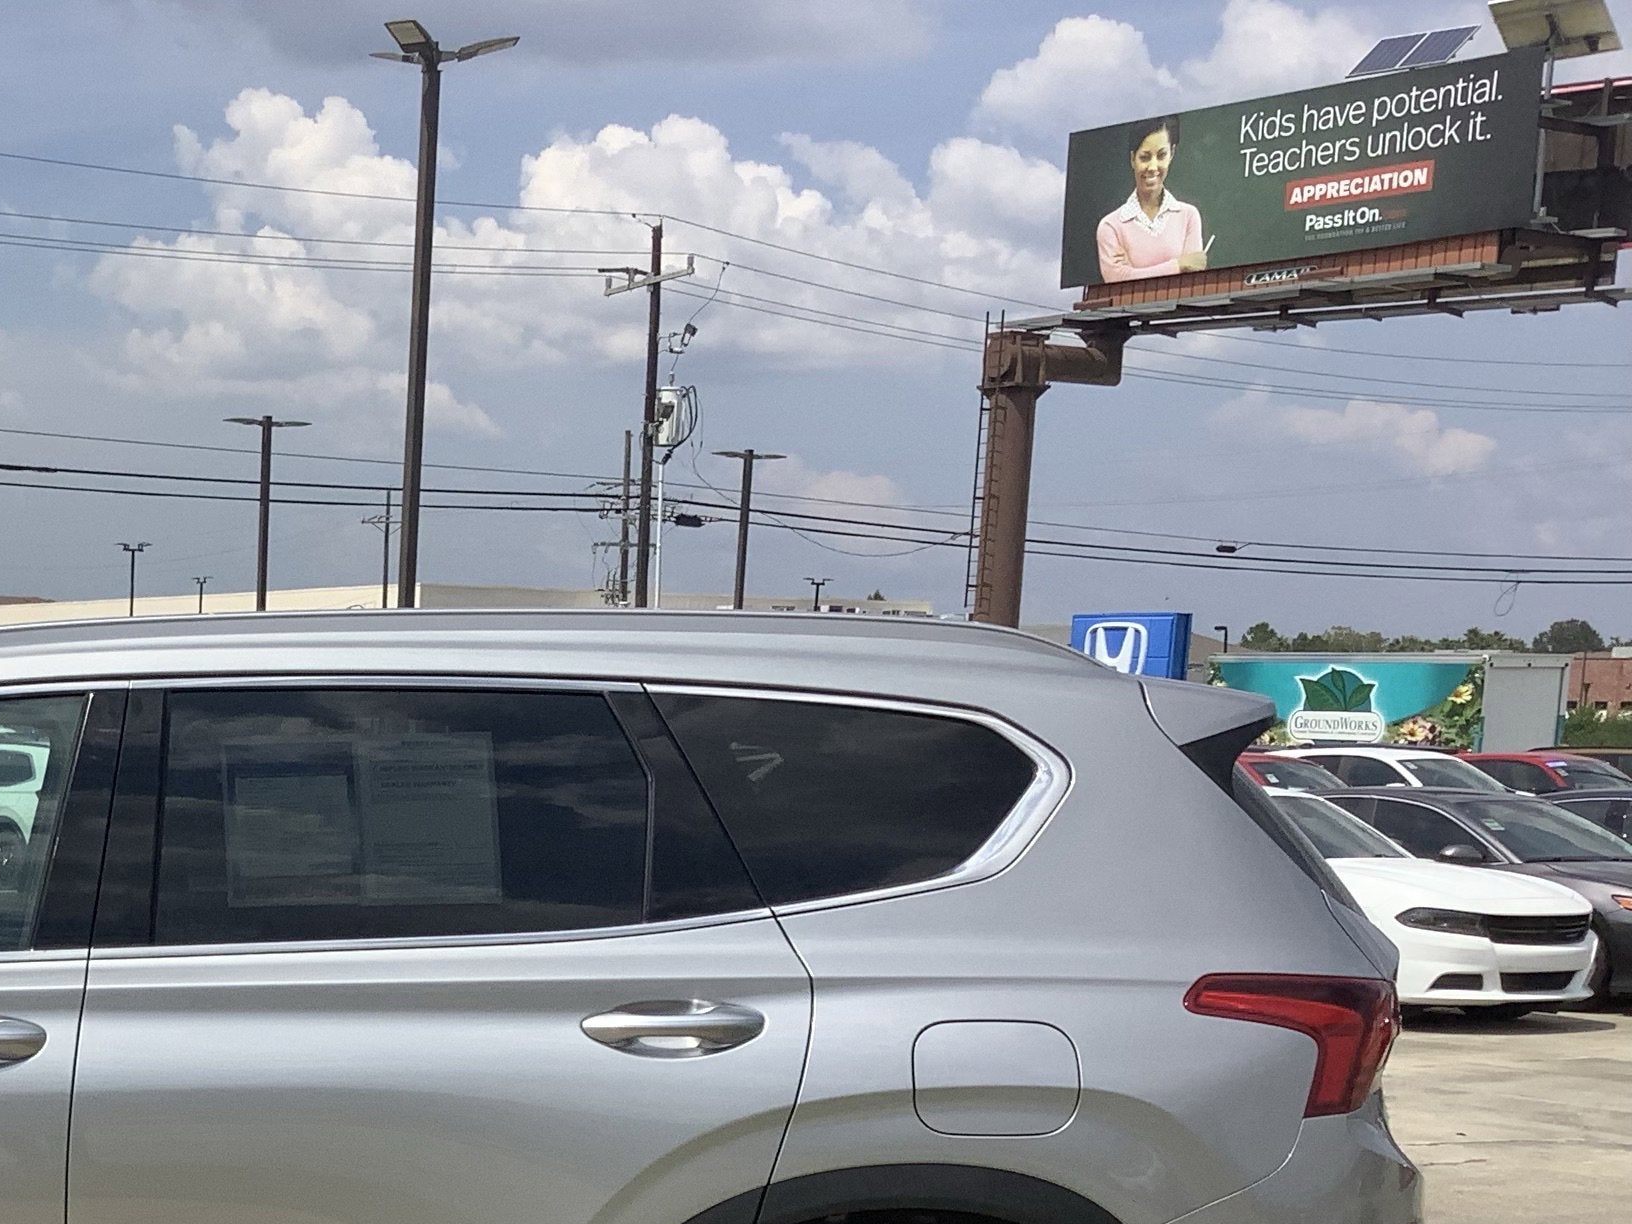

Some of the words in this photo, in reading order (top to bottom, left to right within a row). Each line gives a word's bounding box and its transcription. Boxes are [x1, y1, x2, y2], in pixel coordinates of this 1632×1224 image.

[1239, 108, 1297, 144] Kids
[1301, 99, 1367, 134] have
[1372, 70, 1504, 127] potential.
[1239, 137, 1361, 178] Teachers
[1366, 115, 1462, 157] unlock
[1467, 111, 1492, 142] it.
[1289, 167, 1429, 205] APPRECIATION
